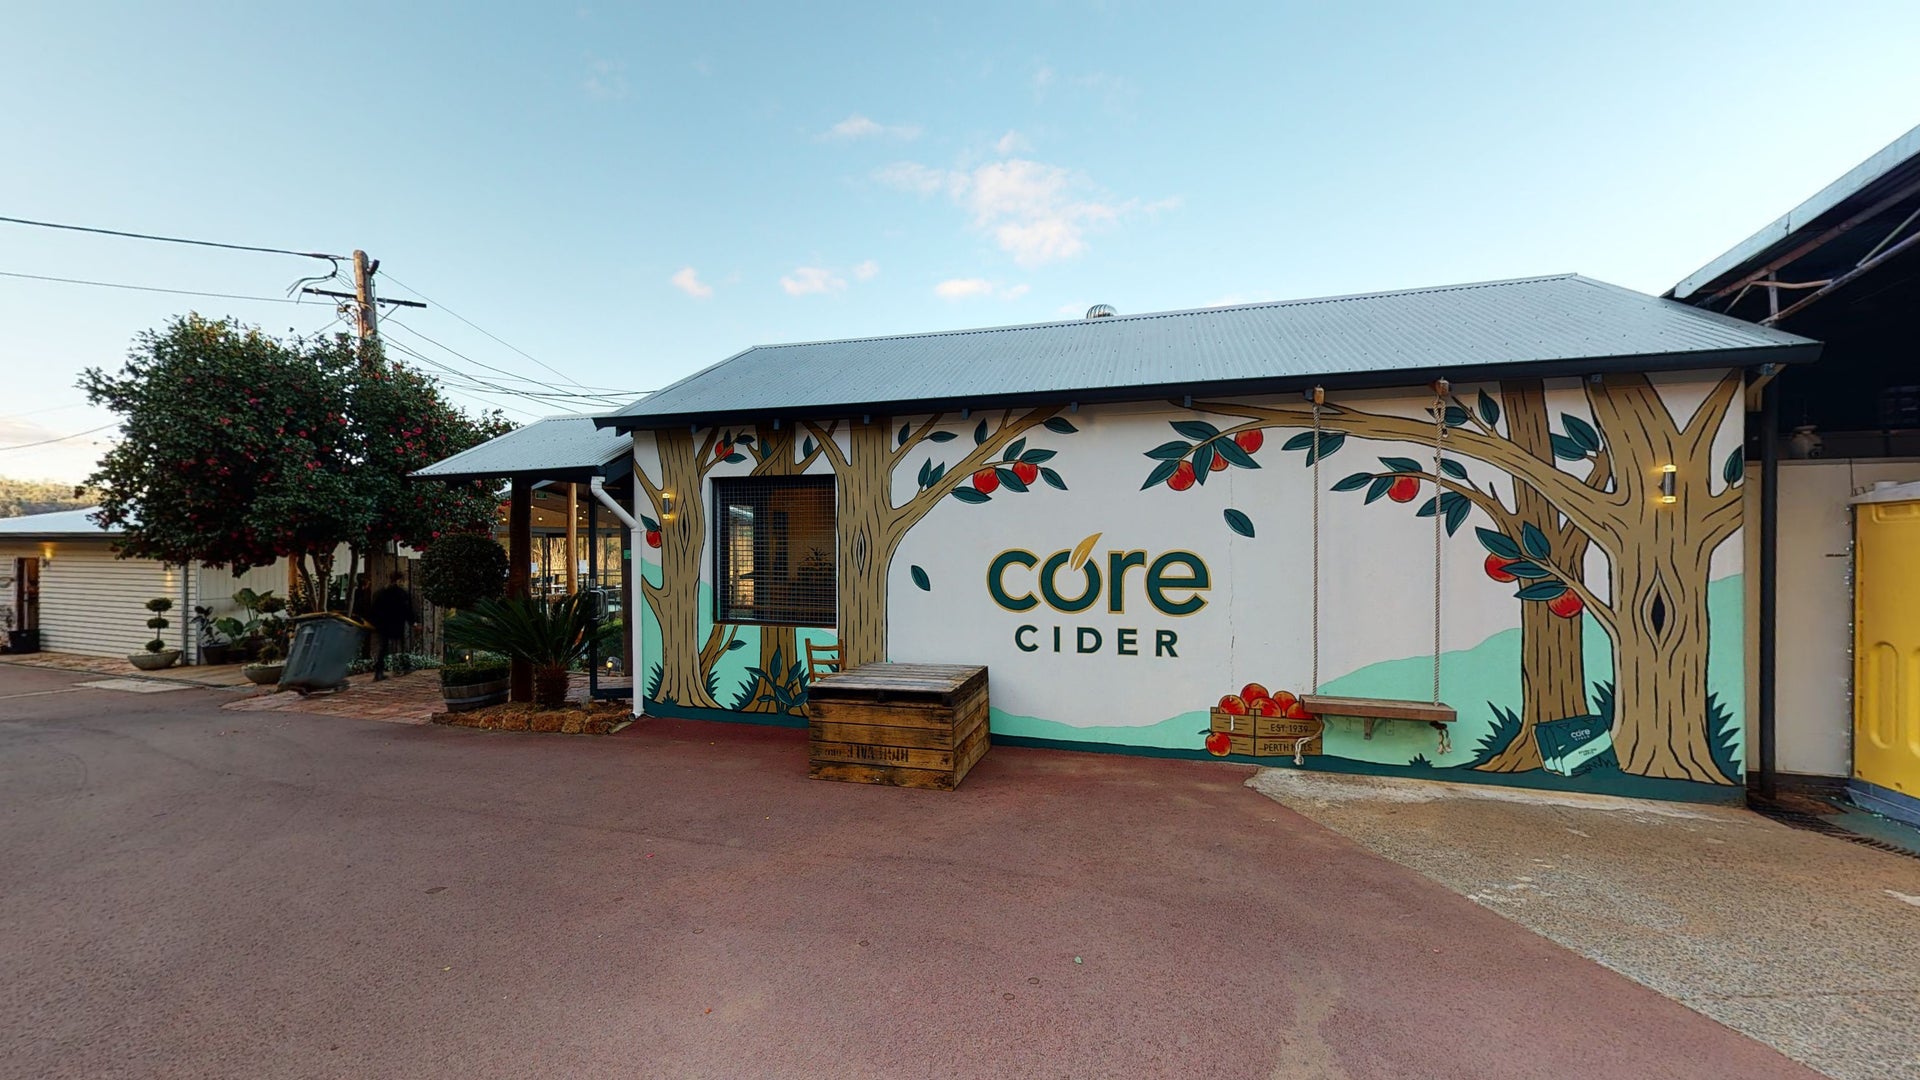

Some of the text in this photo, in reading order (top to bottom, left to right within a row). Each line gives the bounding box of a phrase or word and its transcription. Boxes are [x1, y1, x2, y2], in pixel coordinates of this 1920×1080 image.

[986, 547, 1211, 618] core
[1014, 624, 1179, 658] CIDER
[1289, 724, 1309, 733] 1939
[1570, 728, 1591, 738] core
[1263, 743, 1313, 752] PERTH HLLS
